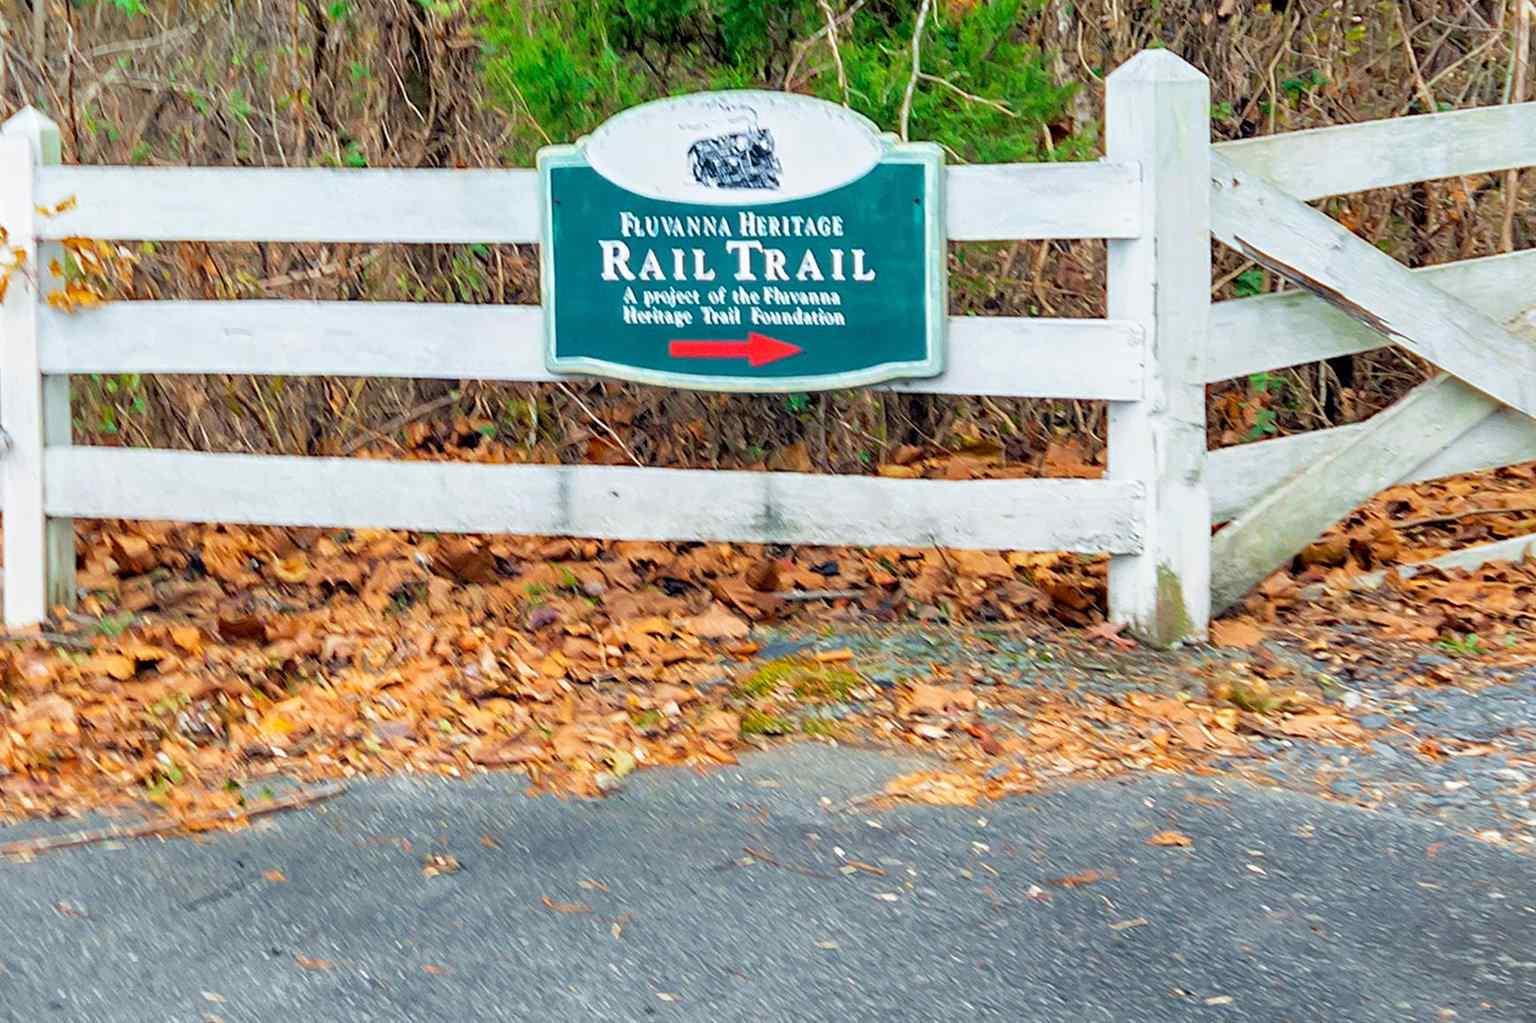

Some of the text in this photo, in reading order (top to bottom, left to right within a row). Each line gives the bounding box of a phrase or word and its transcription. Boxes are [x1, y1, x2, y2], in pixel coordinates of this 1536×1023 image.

[619, 211, 844, 238] FLUVANNA HERITAGE
[599, 240, 876, 282] RAIL TRAIL
[623, 286, 841, 310] A project of the Fluvanna
[623, 306, 846, 329] Heritage Trail Foundation
